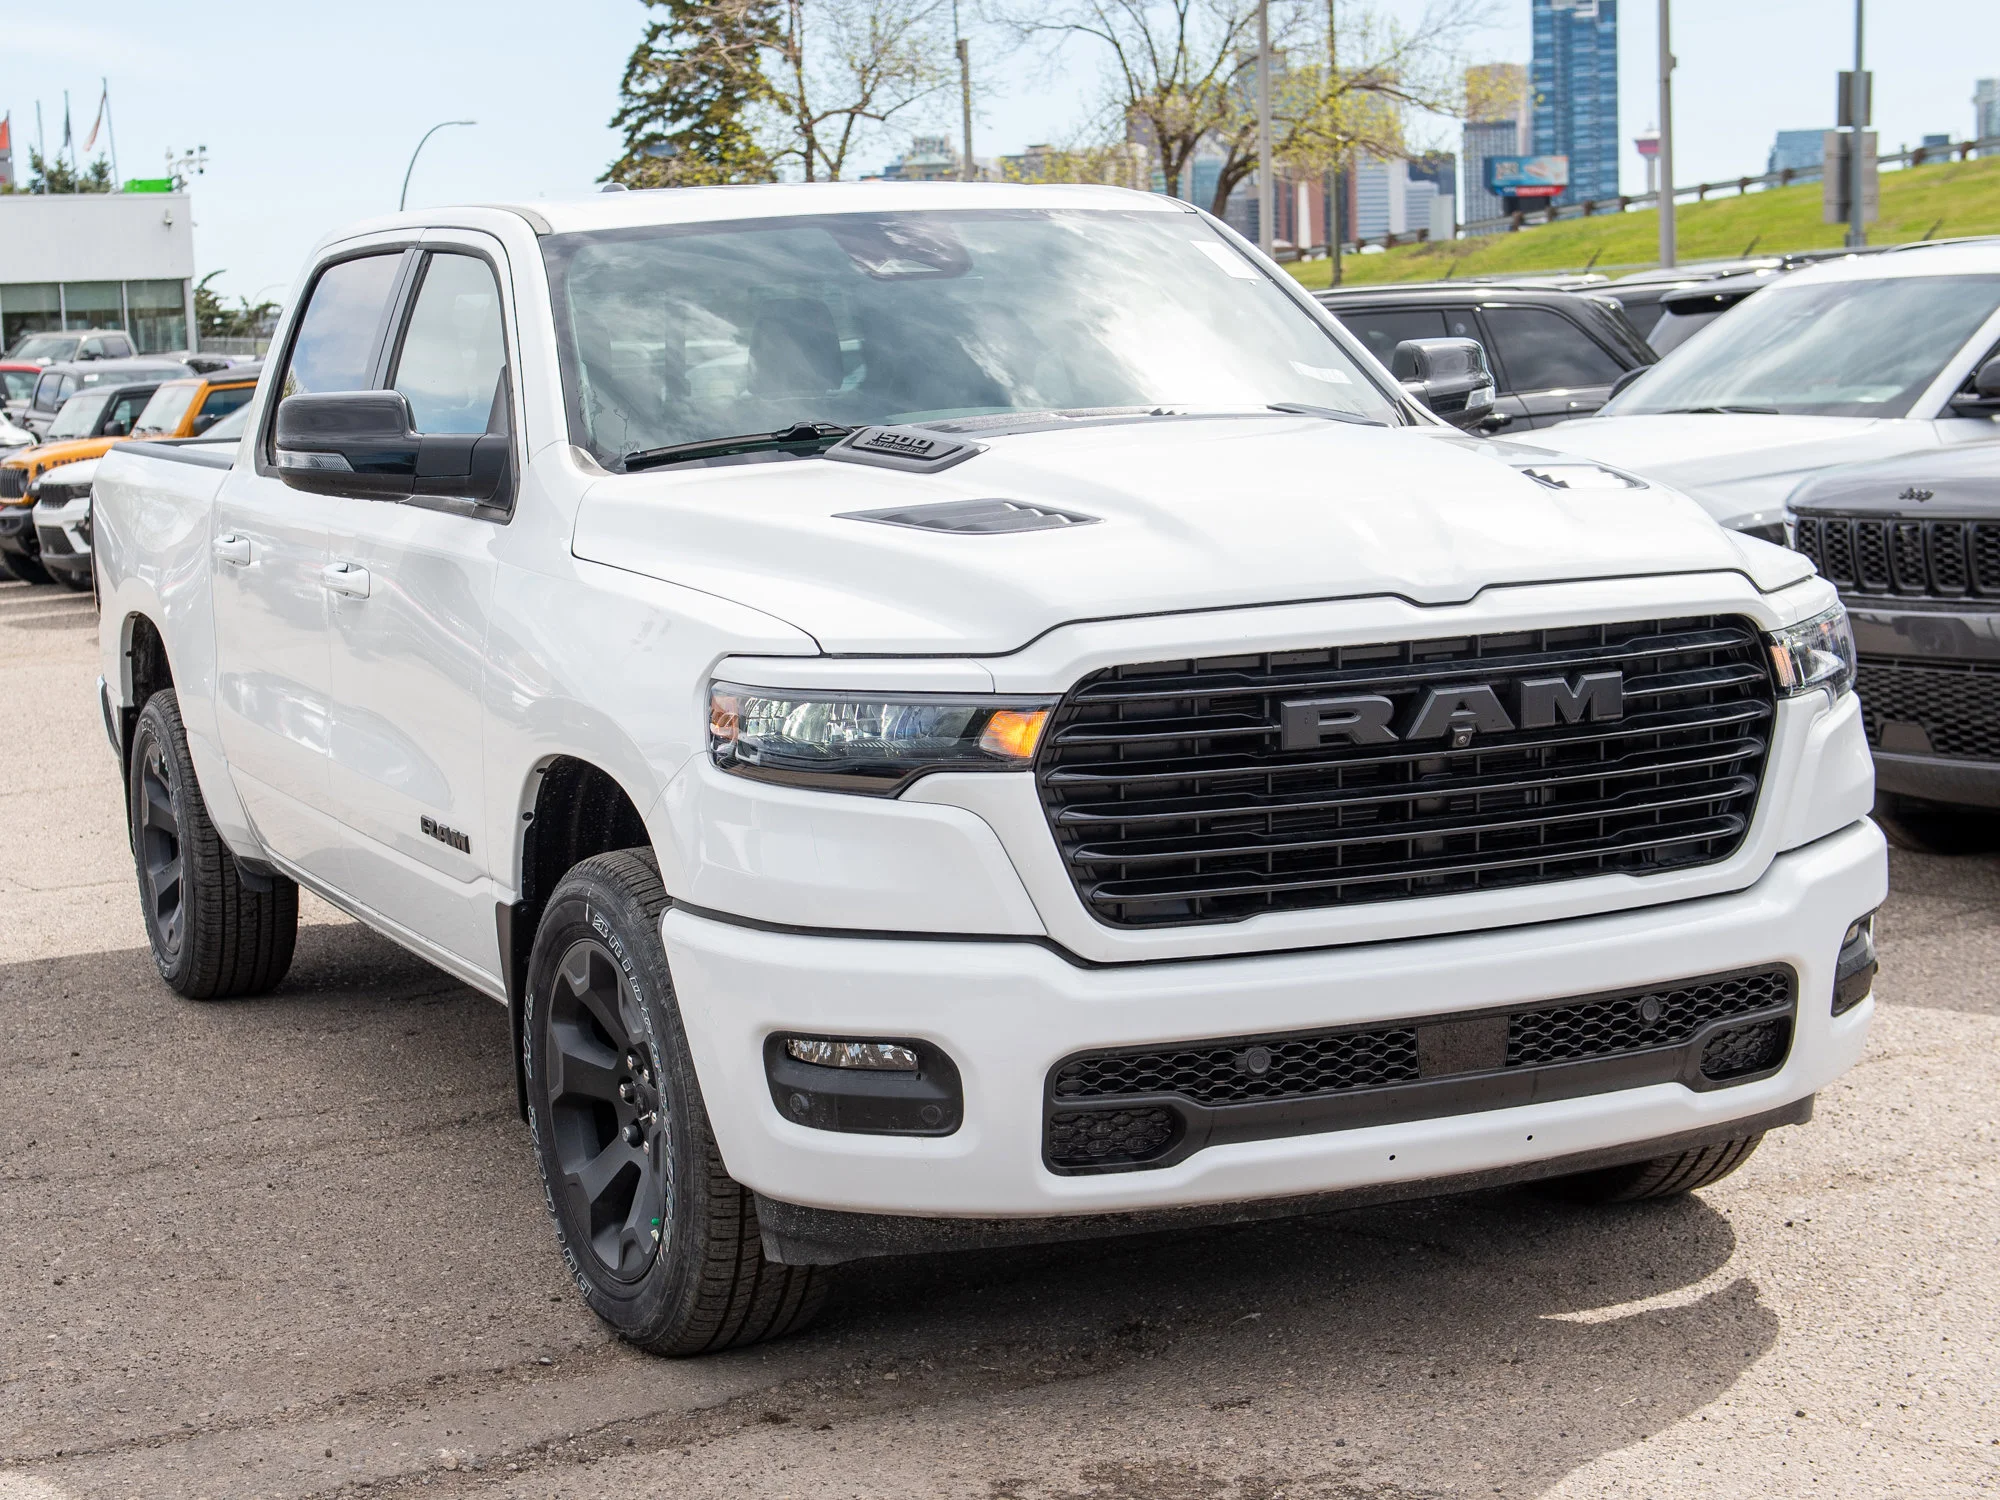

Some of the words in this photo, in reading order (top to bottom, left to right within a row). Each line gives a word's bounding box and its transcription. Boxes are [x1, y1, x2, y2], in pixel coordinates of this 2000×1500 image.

[872, 432, 935, 449] 1500
[1899, 487, 1935, 503] Jeep
[1281, 671, 1623, 750] RAM
[421, 814, 470, 854] RAM
